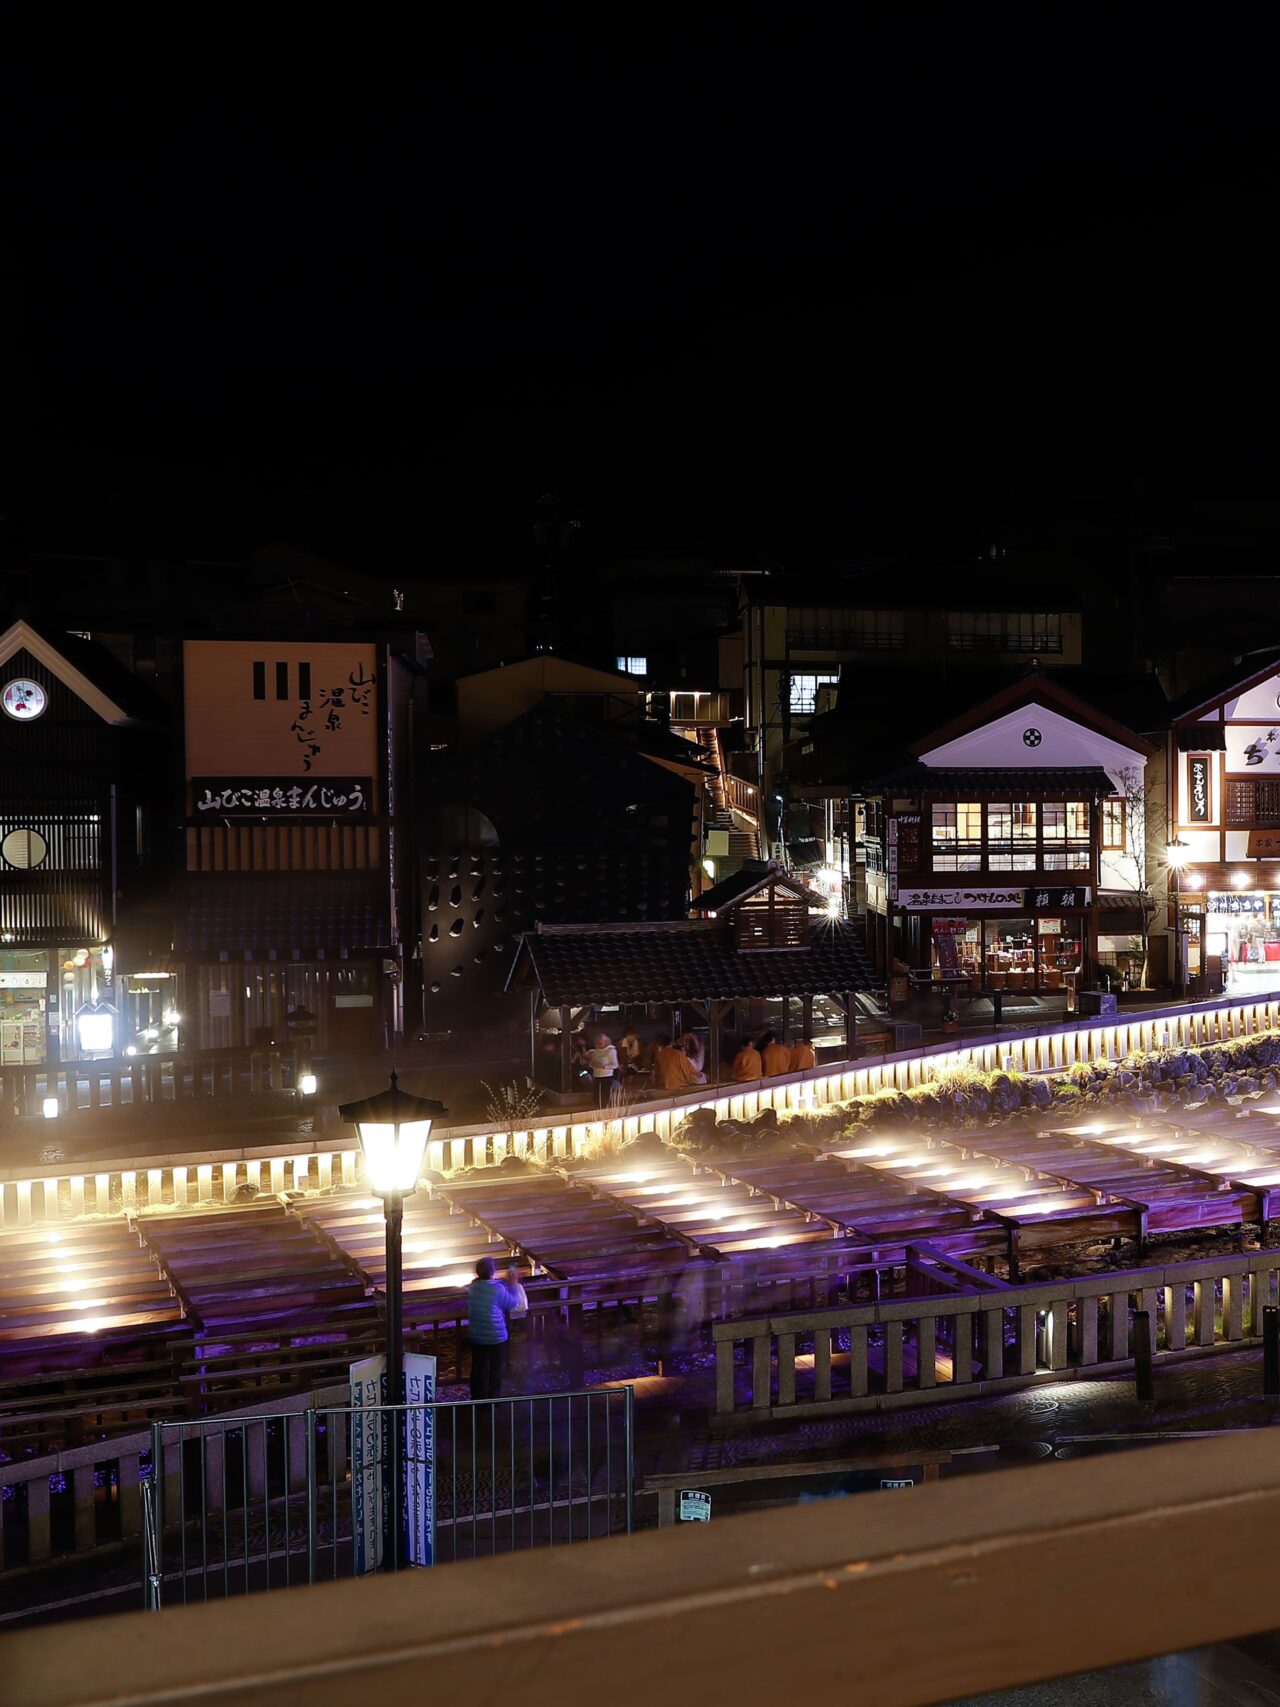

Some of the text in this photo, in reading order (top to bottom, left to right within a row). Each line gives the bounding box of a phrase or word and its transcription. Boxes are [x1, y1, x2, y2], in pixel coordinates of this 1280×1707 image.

[319, 688, 346, 731] 温泉
[197, 785, 364, 811] 山びこ温泉まんじゅう
